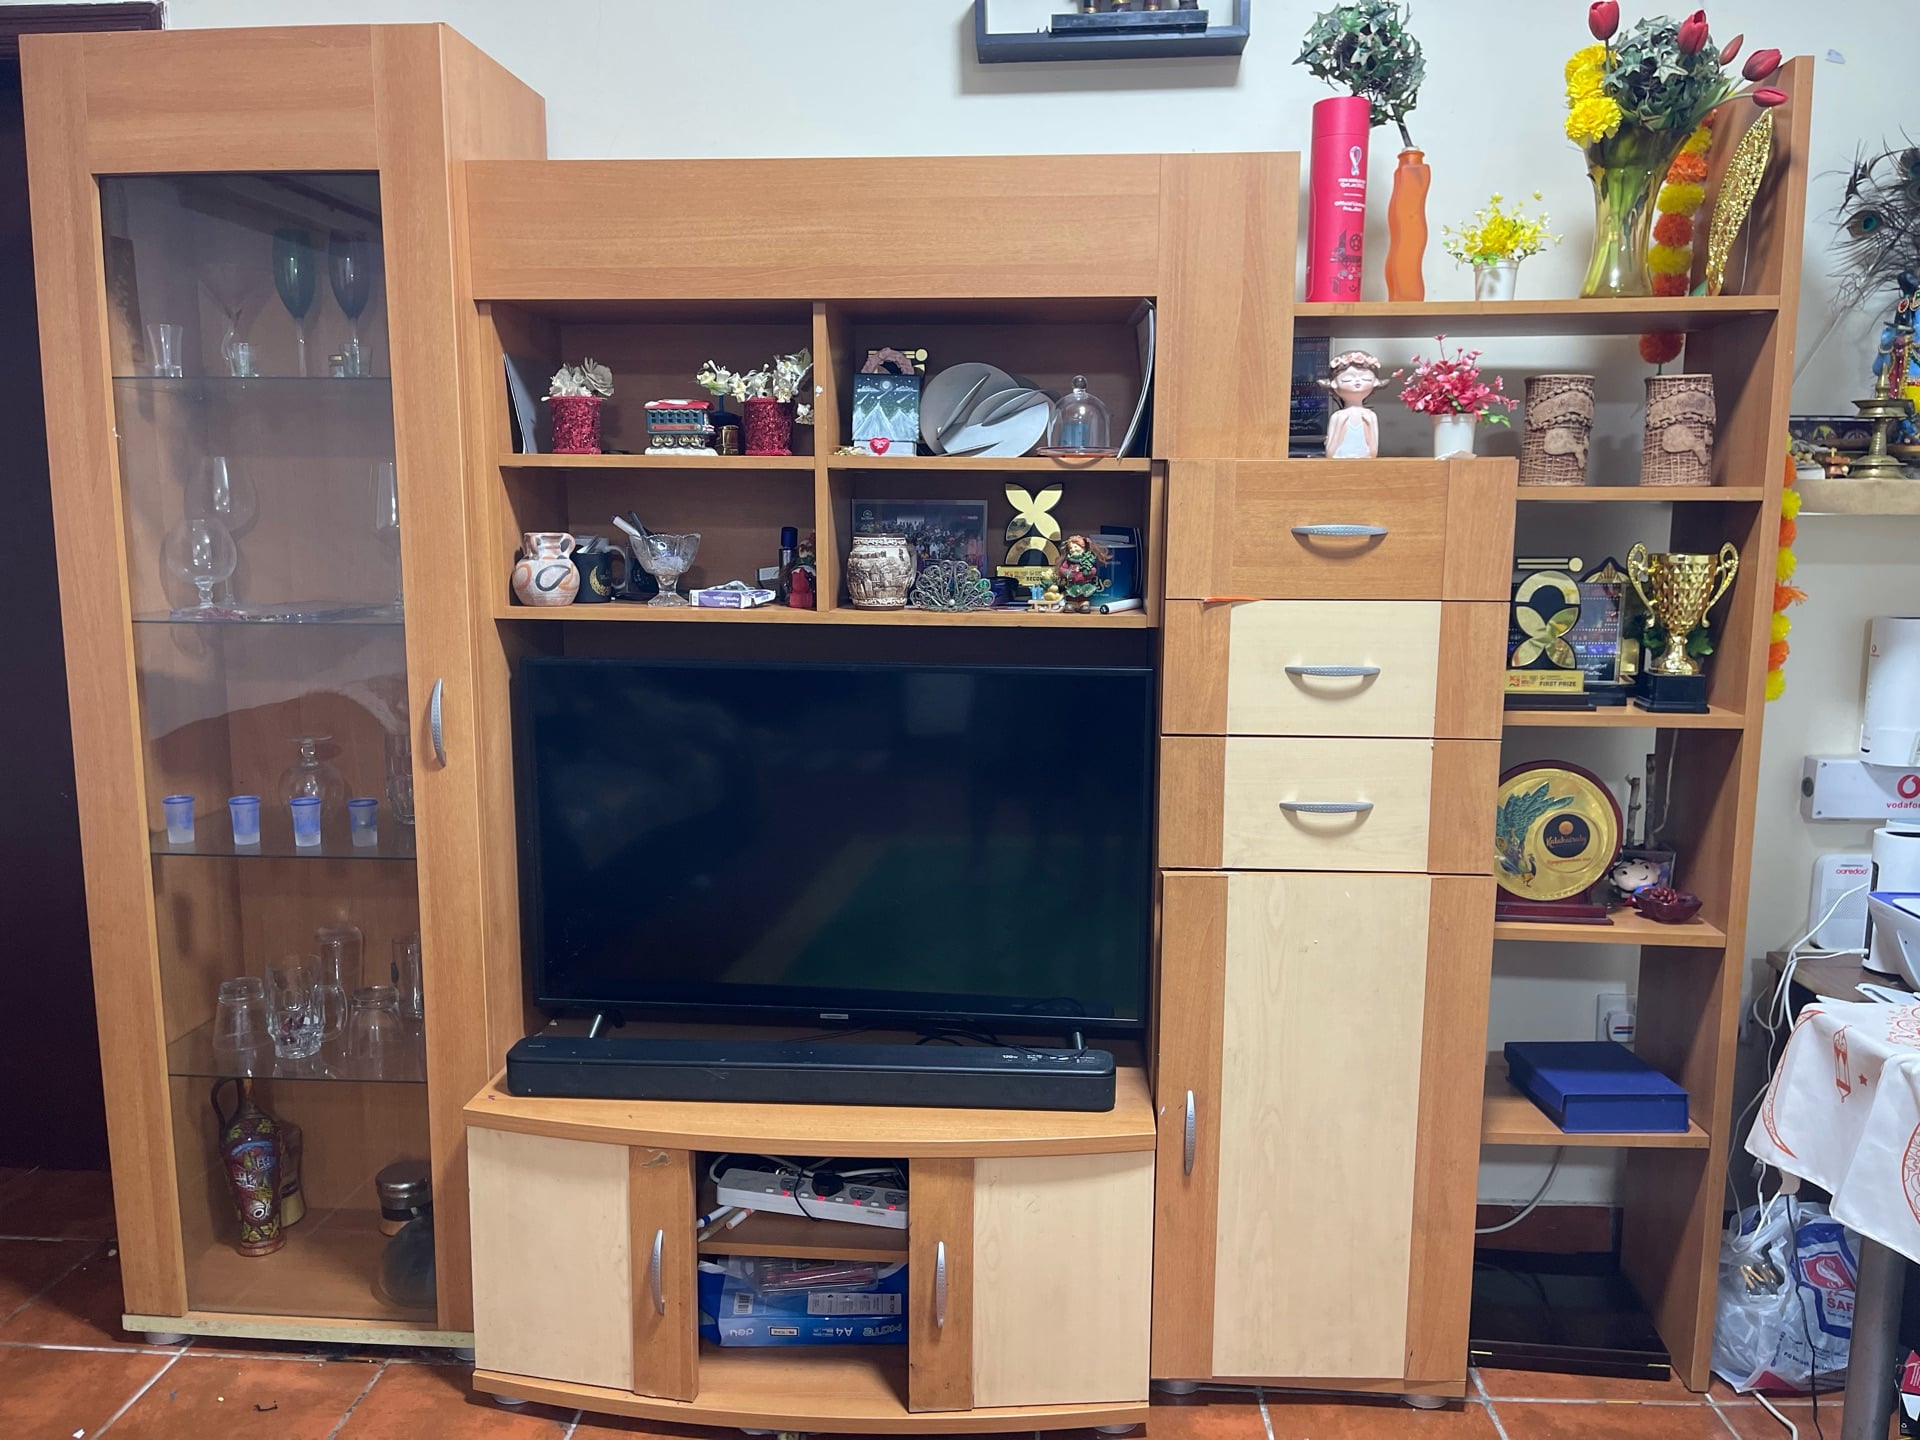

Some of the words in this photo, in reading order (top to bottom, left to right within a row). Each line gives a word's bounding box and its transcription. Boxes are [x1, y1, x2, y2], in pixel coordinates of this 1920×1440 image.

[1886, 801, 1920, 809] vodafo
[1827, 1297, 1854, 1312] SAF
[835, 1327, 853, 1337] A4
